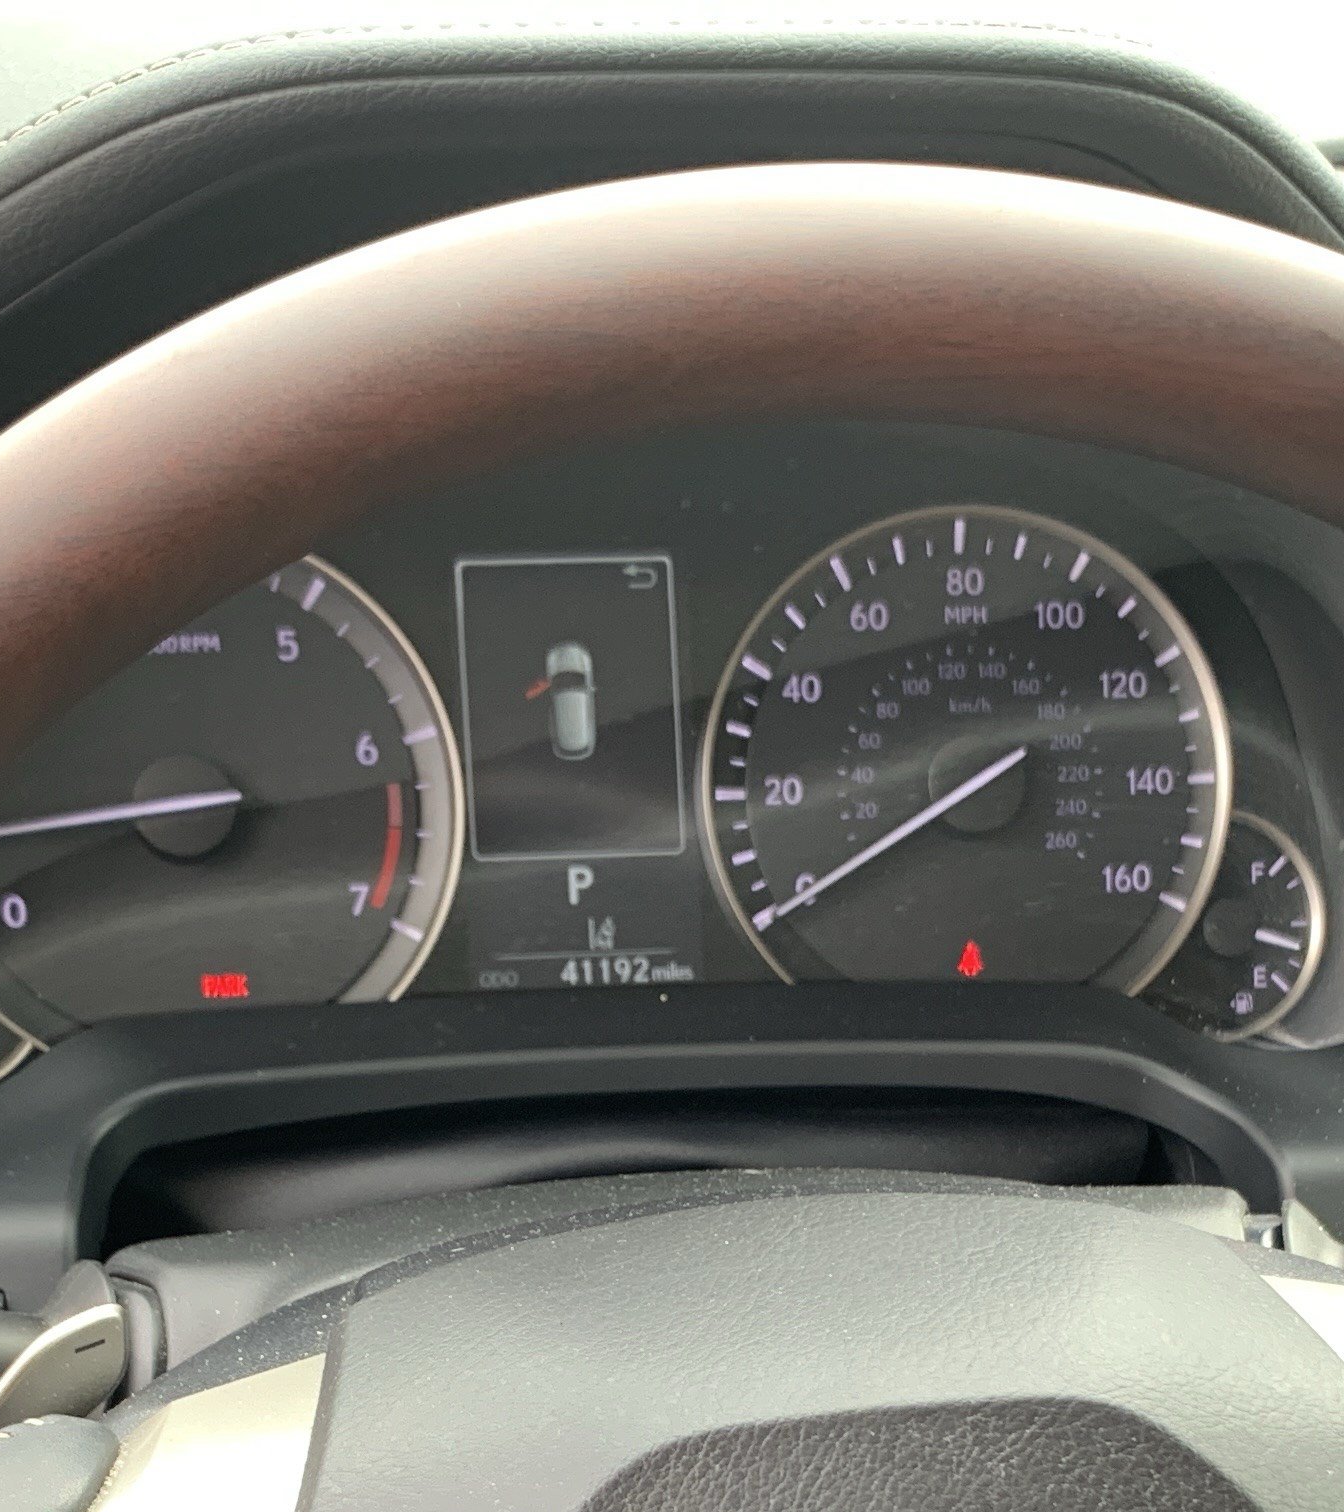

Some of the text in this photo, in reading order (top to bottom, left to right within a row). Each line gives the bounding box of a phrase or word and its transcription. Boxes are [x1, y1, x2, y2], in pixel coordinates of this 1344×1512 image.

[946, 567, 985, 596] 80
[849, 602, 889, 631] 60
[943, 605, 989, 625] MPH
[1034, 601, 1084, 630] 100
[275, 627, 300, 663] 5
[937, 661, 967, 680] 120
[978, 661, 1007, 679] 140
[781, 674, 822, 703] 40
[902, 677, 931, 696] 100
[1012, 678, 1041, 696] 160
[1099, 669, 1148, 700] 120
[875, 701, 901, 720] 80
[948, 697, 993, 714] km/h
[1037, 703, 1066, 721] 180
[357, 734, 379, 766] 6
[858, 733, 882, 750] 60
[1049, 732, 1083, 750] 200
[851, 766, 875, 784] 40
[1057, 765, 1090, 783] 220
[1126, 766, 1174, 796] 140
[764, 776, 802, 805] 20
[855, 802, 879, 820] 20
[1056, 799, 1088, 816] 240
[1044, 832, 1077, 850] 260
[1103, 863, 1151, 893] 160
[1250, 860, 1265, 885] F
[567, 865, 594, 906] P
[0, 894, 27, 929] 0
[349, 882, 369, 917] 7
[560, 956, 649, 985] 41192
[1253, 964, 1267, 989] E
